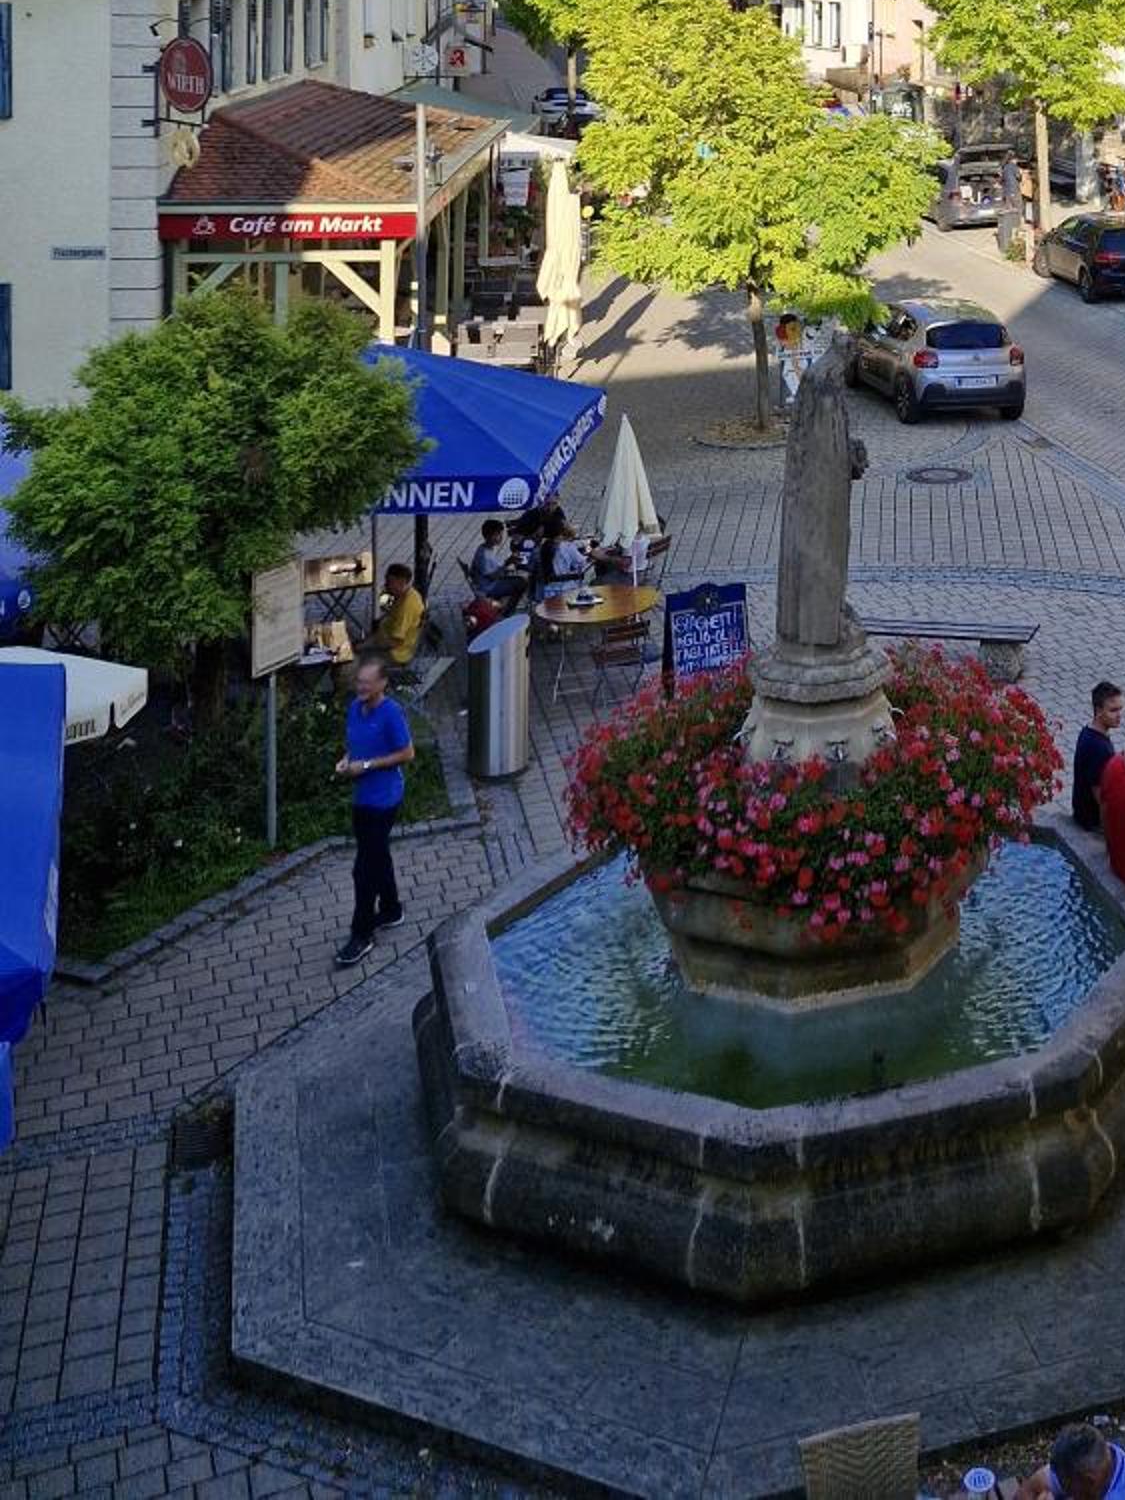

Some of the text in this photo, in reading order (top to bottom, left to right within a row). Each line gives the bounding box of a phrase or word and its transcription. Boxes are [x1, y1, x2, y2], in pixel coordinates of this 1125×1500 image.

[228, 215, 384, 236] Café am Markt
[376, 481, 475, 508] NNEN
